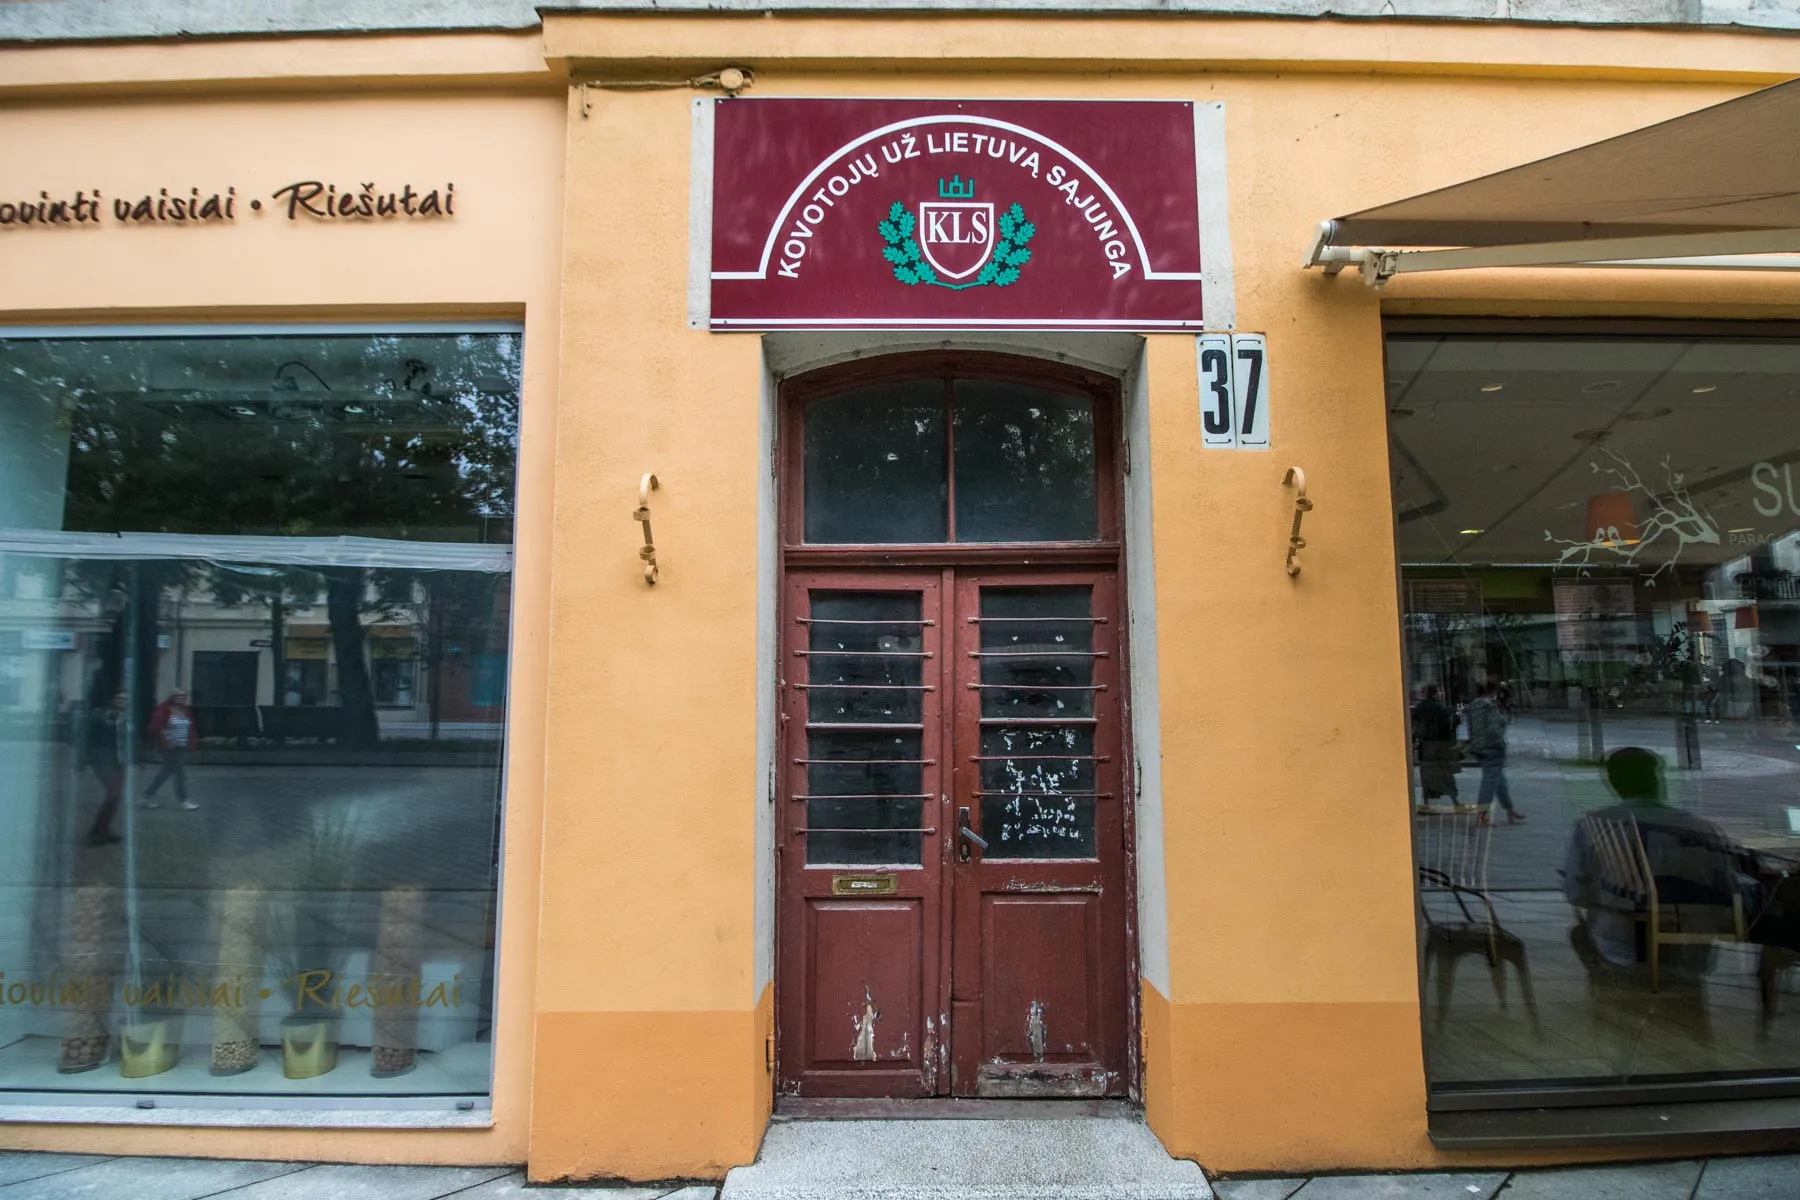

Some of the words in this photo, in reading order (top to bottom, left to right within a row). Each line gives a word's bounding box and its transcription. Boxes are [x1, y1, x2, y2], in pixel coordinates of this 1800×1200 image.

[113, 187, 235, 222] vaisiai
[272, 181, 454, 220] Riešutai
[778, 153, 879, 279] KOVOTOJŲ
[881, 134, 921, 164] UŽ
[927, 132, 1040, 179] LIETUVĄ
[1046, 165, 1132, 281] SĄJUNGA
[926, 210, 988, 244] KLS
[1201, 349, 1263, 434] 37
